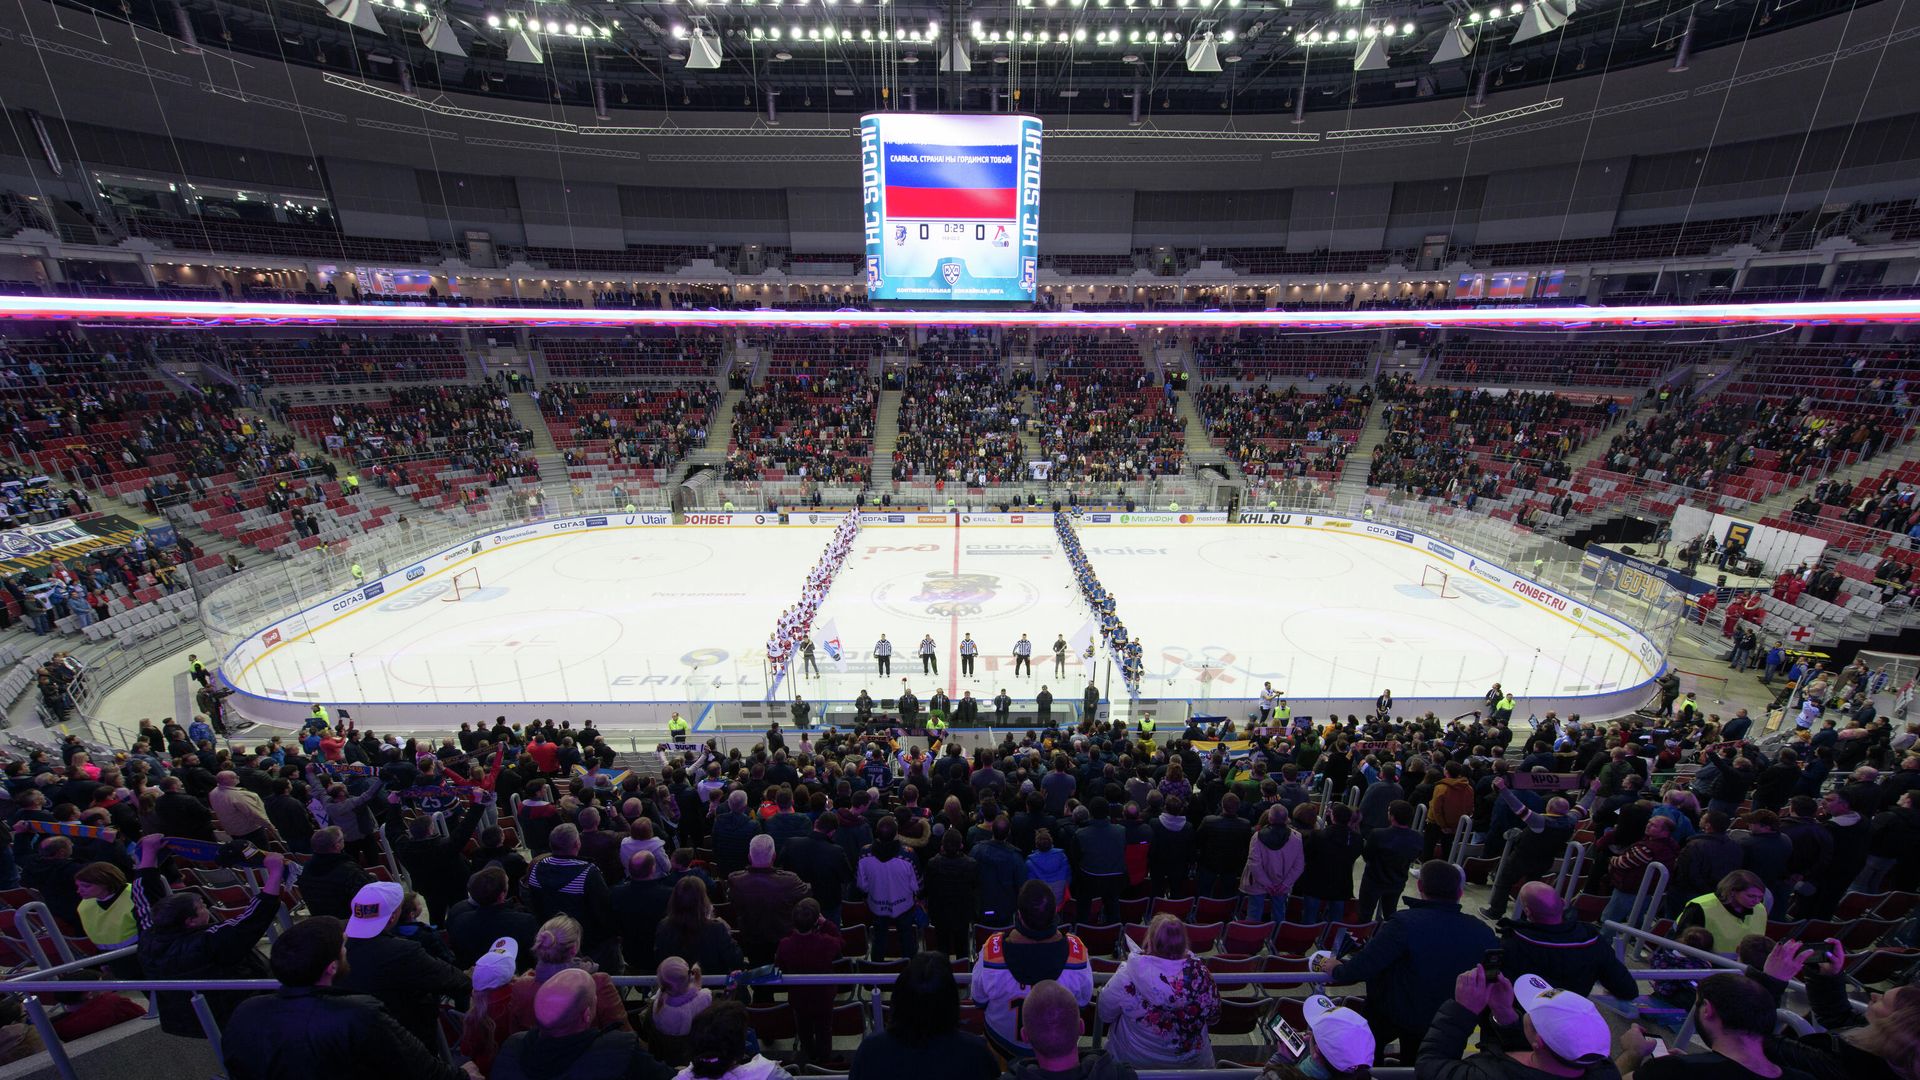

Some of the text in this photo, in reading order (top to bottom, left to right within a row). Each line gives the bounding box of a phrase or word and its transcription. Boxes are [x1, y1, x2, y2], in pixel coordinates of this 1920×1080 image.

[890, 155, 919, 163] СЛАВЬСЯ,
[957, 156, 989, 164] ГОРДИМСЯ
[861, 126, 880, 245] HC SOCHI
[1022, 128, 1041, 247] HC SOCHI
[920, 224, 929, 240] 0
[944, 223, 965, 233] 0:29
[976, 224, 985, 240] 0
[553, 520, 585, 530] СОГАЗ
[641, 515, 667, 525] Utair
[1239, 513, 1292, 525] KHL.RU
[1366, 525, 1396, 537] СОГАЗ
[332, 592, 364, 611] СОГАЗ
[1512, 580, 1568, 612] FONBET.RU
[611, 674, 761, 686] ERIELL
[868, 774, 884, 787] 74
